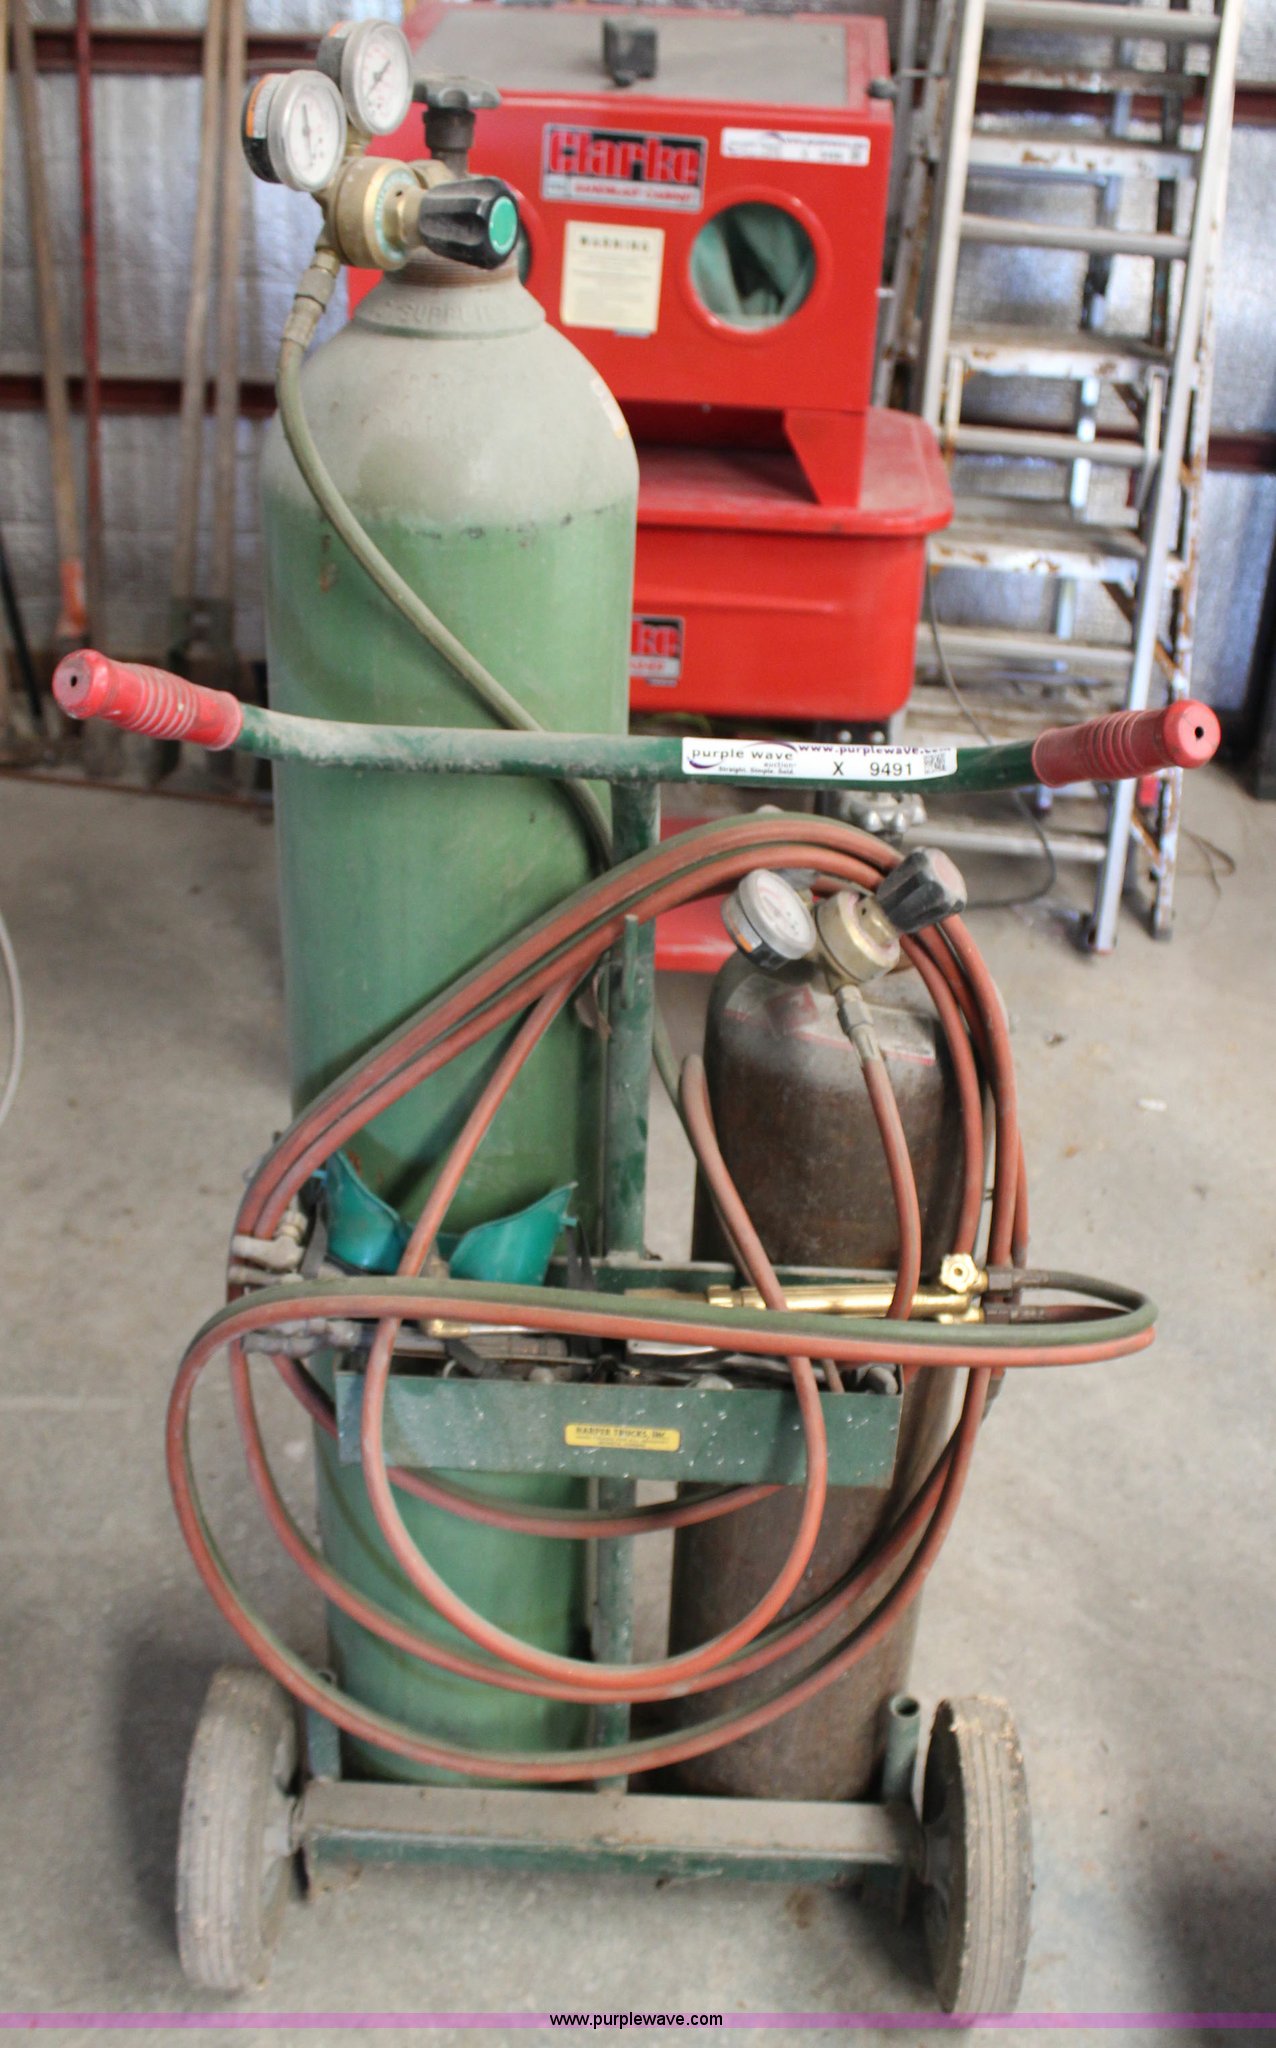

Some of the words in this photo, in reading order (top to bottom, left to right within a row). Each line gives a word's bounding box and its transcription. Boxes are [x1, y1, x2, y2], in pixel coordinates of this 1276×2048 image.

[550, 129, 700, 184] Clarke
[692, 748, 745, 760] purple
[751, 750, 794, 760] wave
[832, 760, 844, 776] X
[870, 761, 912, 776] 9491
